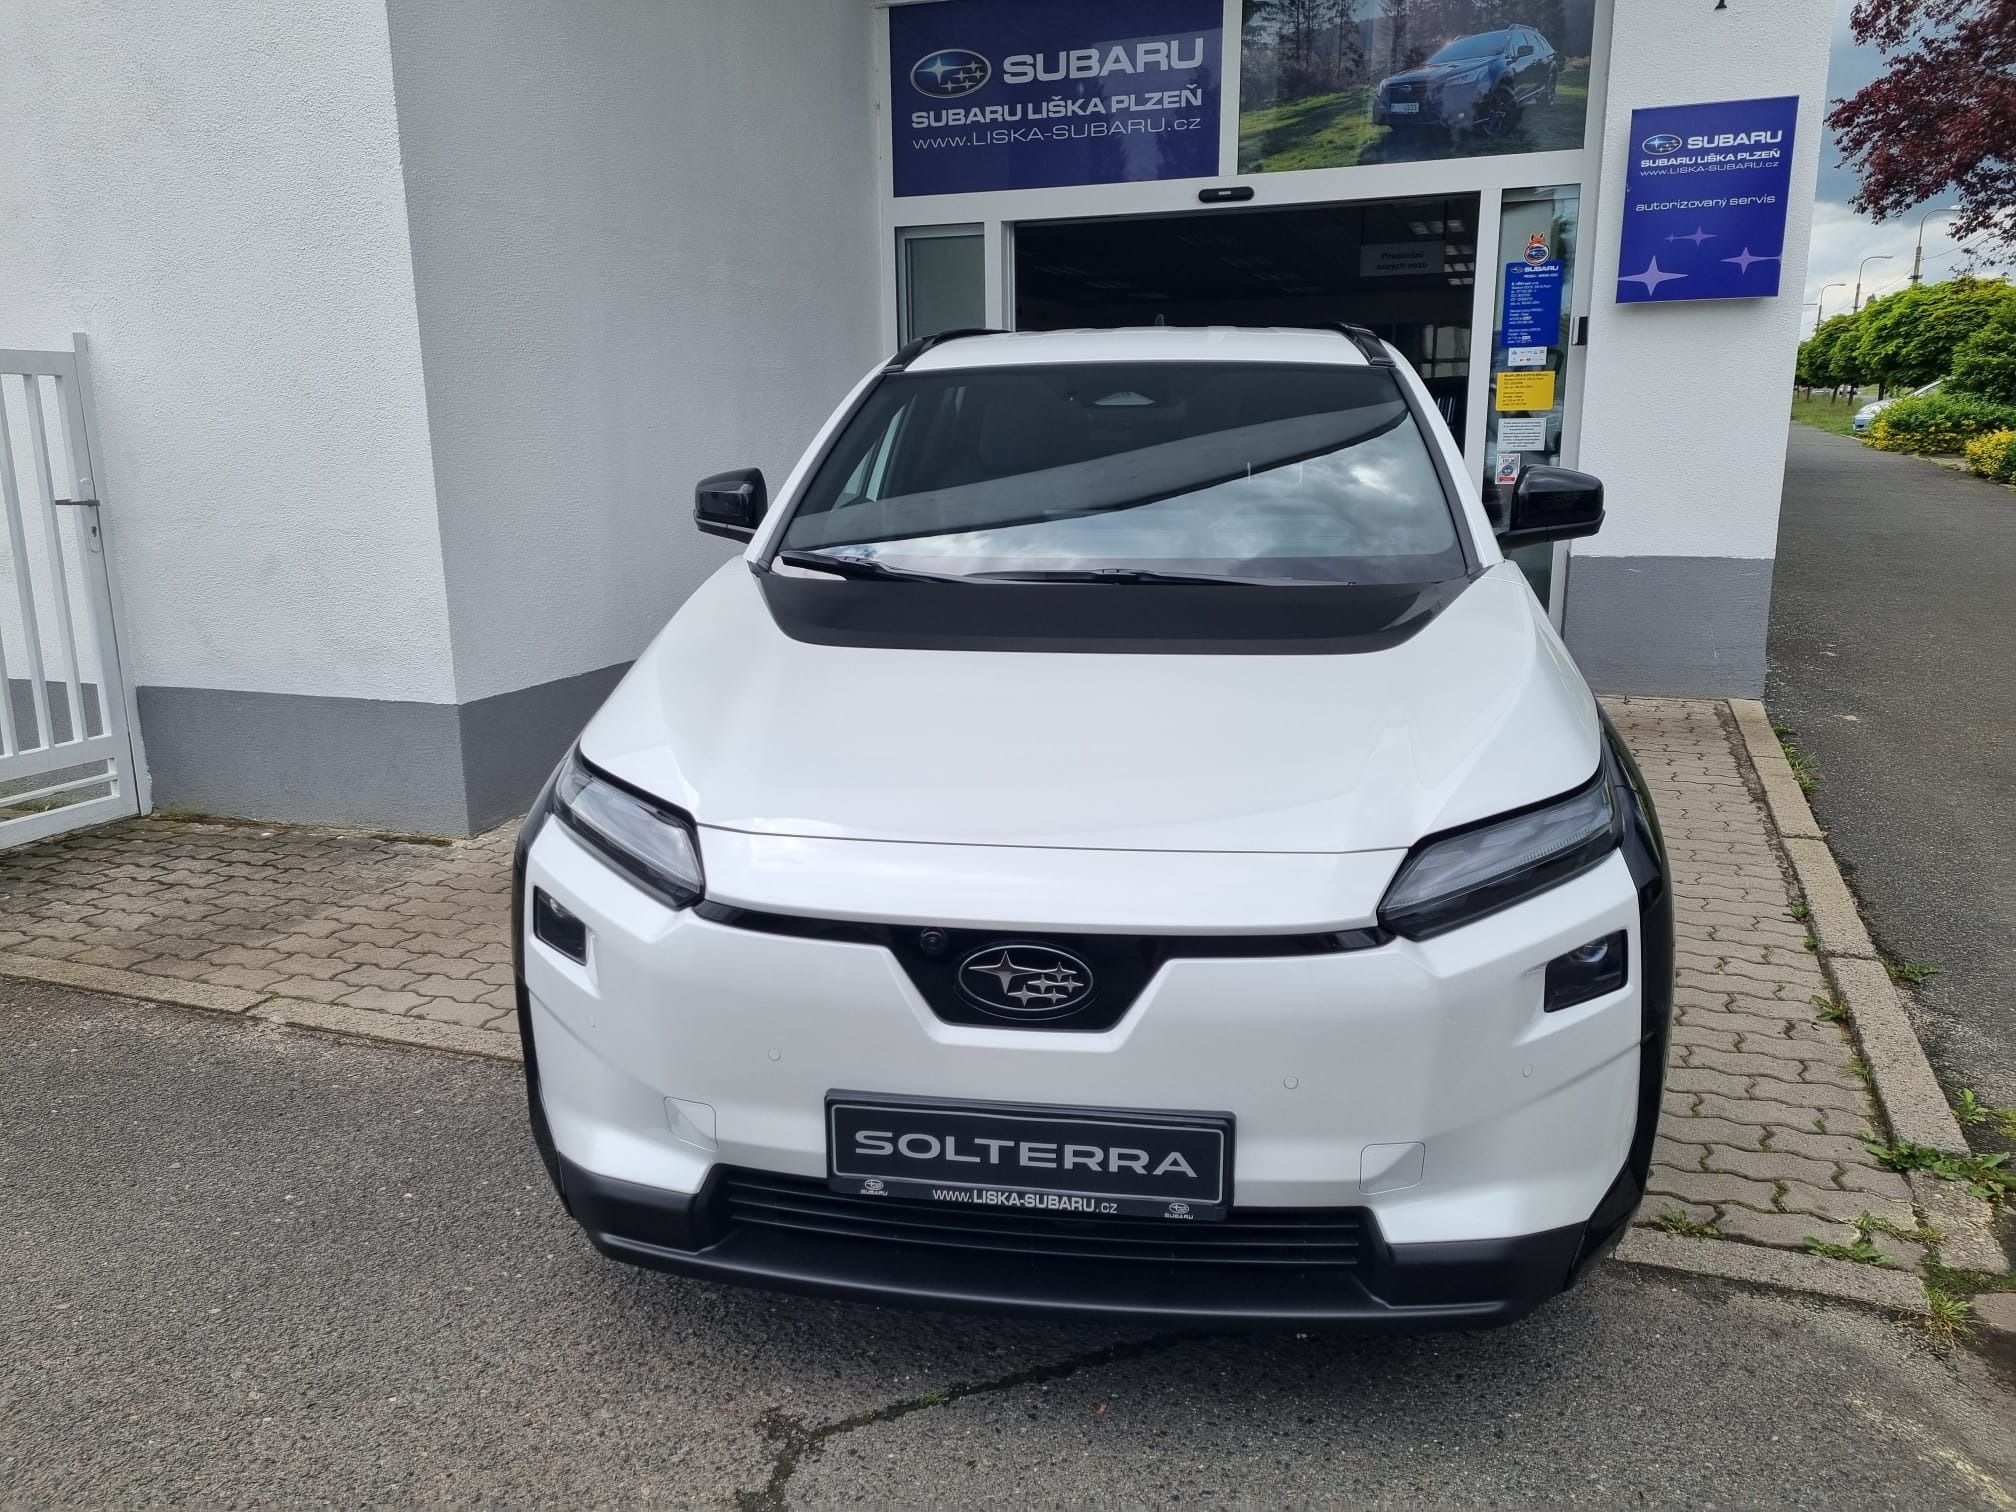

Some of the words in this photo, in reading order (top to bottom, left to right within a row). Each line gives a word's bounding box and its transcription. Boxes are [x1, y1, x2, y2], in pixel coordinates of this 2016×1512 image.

[1003, 37, 1204, 84] SUBARU
[912, 103, 1022, 129] SUBARU
[1027, 95, 1106, 120] LIŠKA
[1111, 84, 1202, 113] PLZEŇ
[912, 117, 1201, 150] www.LISKA-SUBARU.cz
[1687, 130, 1783, 149] SUBARU
[1640, 156, 1695, 168] SUBARU
[1697, 153, 1735, 164] LIŠKA
[1737, 148, 1780, 160] PLZEŇ
[1640, 161, 1779, 177] www.LISKA-SUBARU.cz
[1635, 197, 1727, 212] autorizovaný
[1729, 193, 1776, 206] servis
[1524, 265, 1559, 273] SUBARU
[855, 1130, 1198, 1178] SOLTERRA
[932, 1188, 1117, 1214] www.LISKA-SUBARU.cz
[1164, 1212, 1194, 1220] SUBARU
